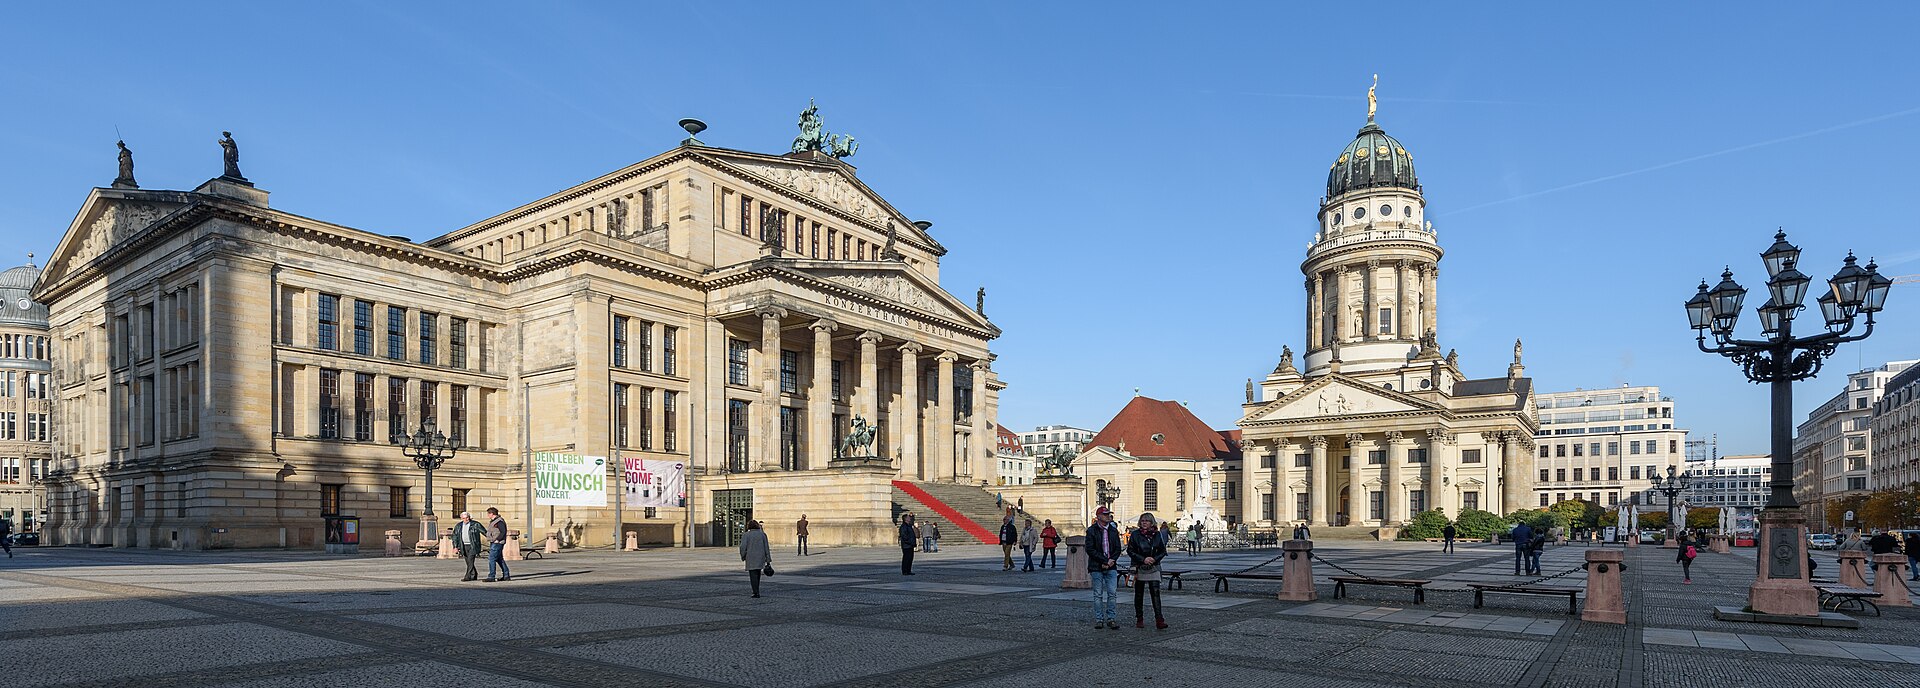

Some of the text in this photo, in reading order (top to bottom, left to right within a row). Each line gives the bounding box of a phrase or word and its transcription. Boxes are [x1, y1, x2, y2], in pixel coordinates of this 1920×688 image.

[824, 295, 955, 339] KONZERTHAUS BERLIN
[535, 452, 555, 462] DEIN
[558, 454, 584, 464] LEBEN
[624, 458, 646, 471] WEL
[535, 462, 545, 470] IST
[536, 471, 603, 491] WUNSCH
[625, 471, 653, 484] COME
[536, 490, 571, 499] KONZERT.
